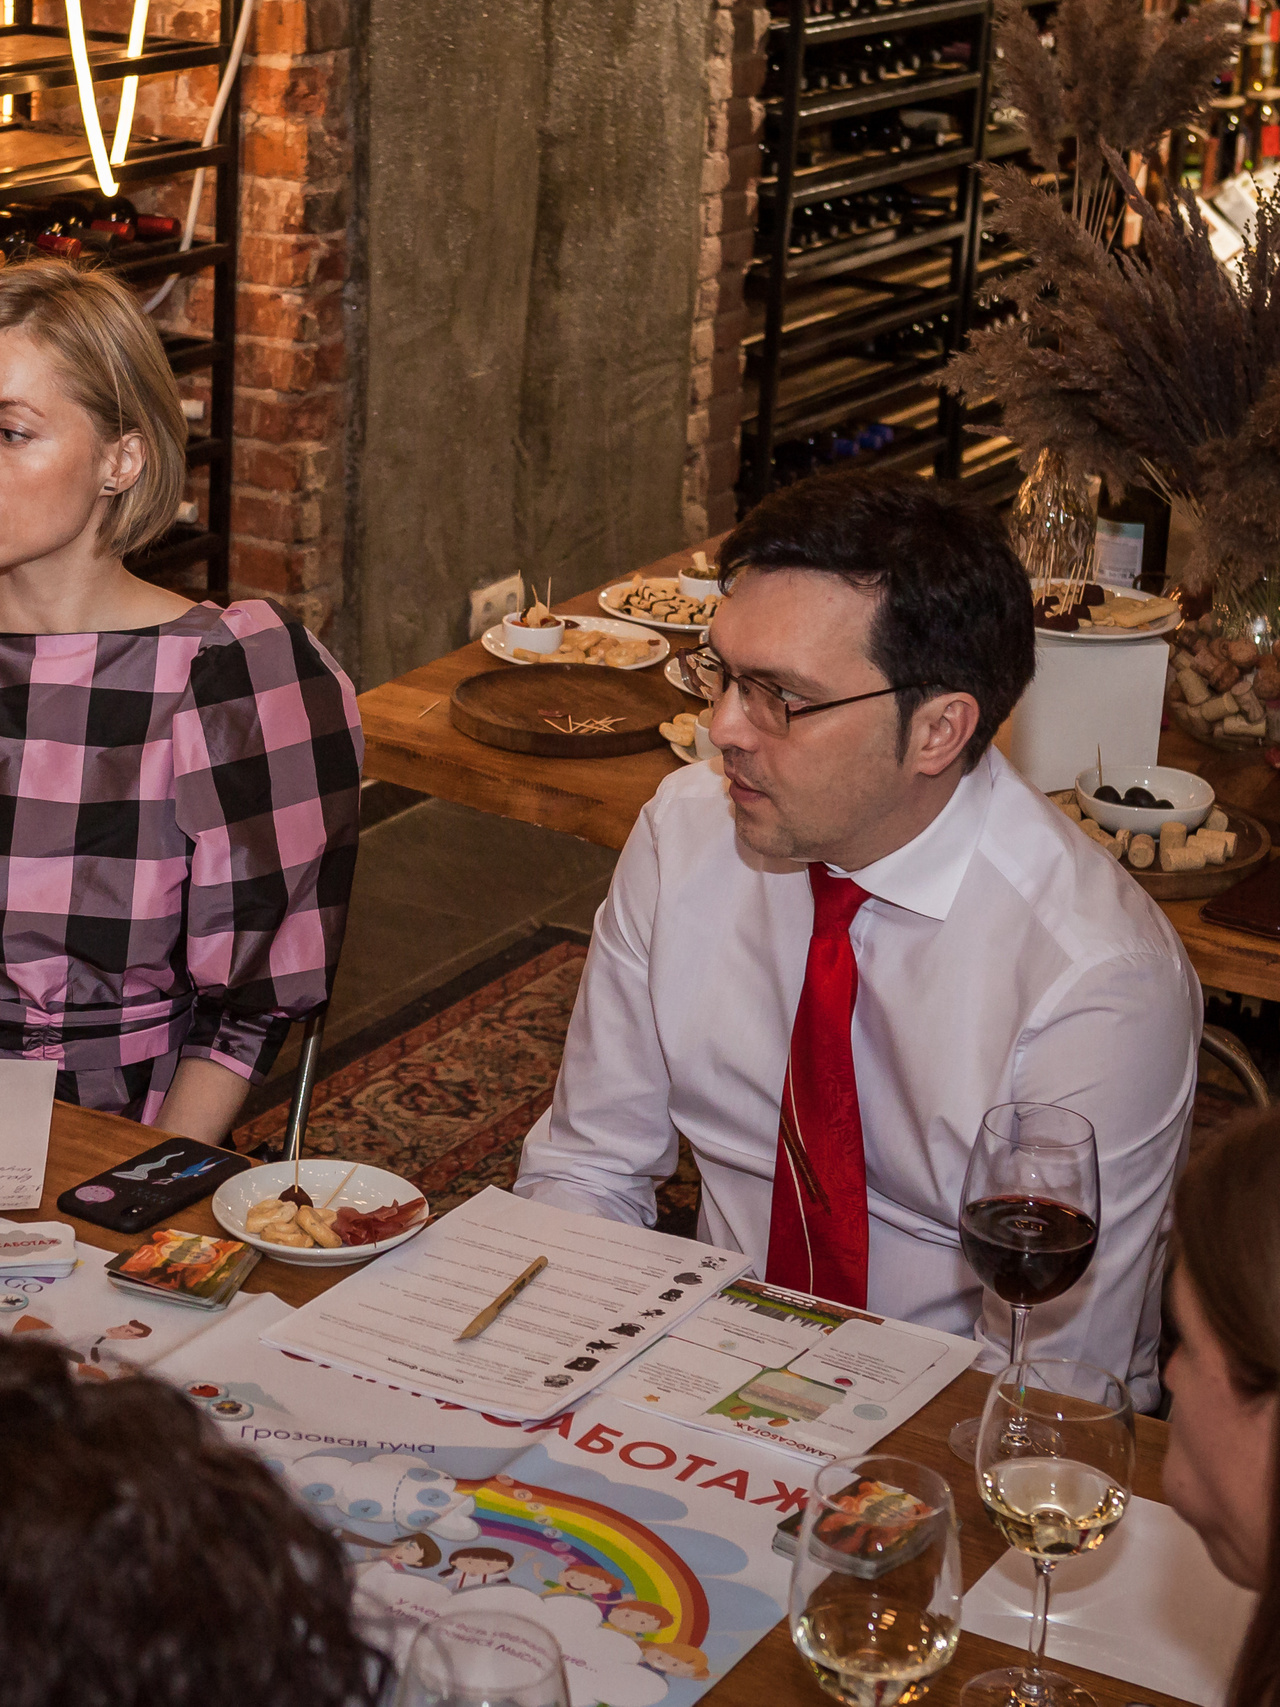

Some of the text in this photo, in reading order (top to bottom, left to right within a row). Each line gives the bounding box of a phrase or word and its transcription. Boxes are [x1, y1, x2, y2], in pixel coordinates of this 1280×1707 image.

[241, 1425, 436, 1454] Грозовая туча
[733, 1420, 837, 1460] САМОСАБОТАЖ
